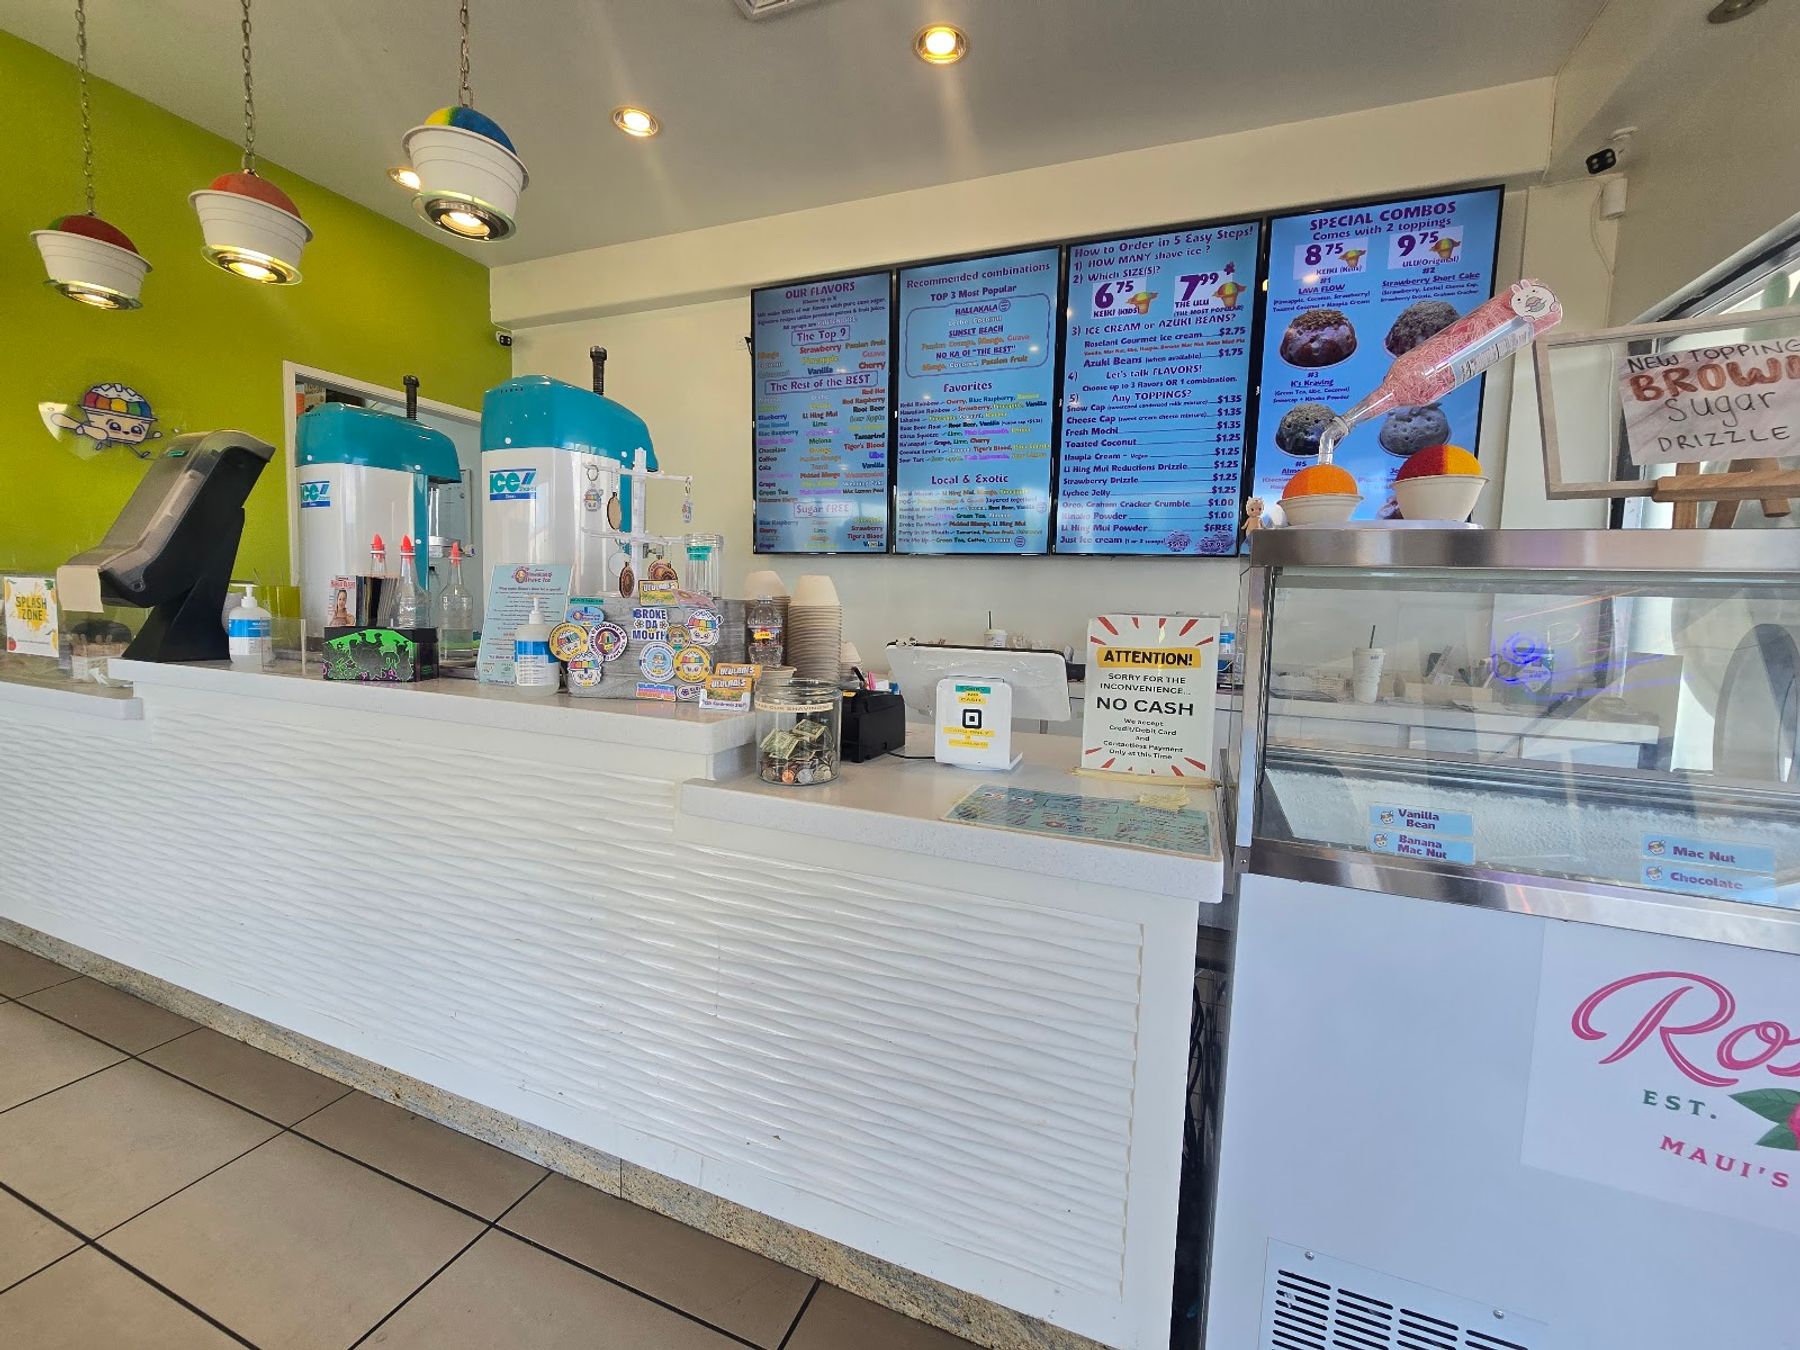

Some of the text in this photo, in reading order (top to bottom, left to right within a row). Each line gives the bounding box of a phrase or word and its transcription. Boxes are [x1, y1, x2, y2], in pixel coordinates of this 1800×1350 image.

[1310, 201, 1456, 231] SPECIAL COMBOS
[1313, 218, 1451, 241] Comes with 2 toppings
[1074, 248, 1100, 257] How
[1104, 245, 1114, 253] to
[1120, 241, 1154, 252] Order
[1158, 238, 1170, 246] in
[1185, 232, 1212, 244] Easy
[1217, 226, 1253, 240] Steps!
[1074, 261, 1082, 271] 1)
[1088, 257, 1114, 268] HOW
[1118, 253, 1150, 264] MANY
[1155, 251, 1183, 260] shave
[1187, 247, 1201, 255] ice
[907, 263, 1050, 288] Recommended combinations
[1073, 266, 1160, 284] 2) Which SIZE(S)?
[1382, 277, 1430, 287] Strawberry
[785, 282, 855, 299] OUR FLAVORS
[931, 285, 1017, 301] TOP 3 Most Popular
[1321, 284, 1345, 293] FLOW
[1193, 299, 1209, 307] ULU
[949, 325, 1003, 337] SUNSET BEACH
[1072, 326, 1081, 336] 3)
[1086, 326, 1100, 335] ICE
[1104, 323, 1140, 333] CREAM
[1158, 317, 1192, 327] AZUKI
[1195, 313, 1236, 324] BEANS?
[797, 328, 846, 341] The Top 9
[1084, 340, 1118, 348] Roselani
[1121, 336, 1157, 345] Gourmet
[1219, 327, 1246, 336] $2.75
[1084, 358, 1110, 368] Azuki
[1113, 357, 1142, 365] Beans
[1218, 348, 1243, 357] $1.75
[1627, 354, 1679, 373] NEW
[1068, 365, 1202, 380] 4) Let's talk FLAVORS!
[770, 375, 870, 391] The Rest of the BEST
[943, 382, 992, 392] Favorites
[1066, 421, 1241, 436] Fresh Mochi $1.35
[1066, 440, 1098, 448] Toasted
[1216, 434, 1241, 442] $1.25
[1658, 426, 1791, 452] DRIZZLE
[1064, 453, 1092, 461] Haupia
[1215, 447, 1239, 456] $1.25
[932, 474, 1008, 485] Local & Exotic
[1063, 477, 1107, 485] Strawberry
[1063, 489, 1089, 497] Lychee
[1091, 489, 1111, 497] Jelly
[797, 506, 823, 516] Sugar
[16, 596, 47, 608] SPLASH
[22, 610, 43, 621] ZONE
[633, 609, 666, 618] BROKE
[646, 620, 657, 628] DA
[633, 631, 667, 640] MOUTH
[1104, 650, 1192, 666] ATTENTION!
[1109, 673, 1141, 681] SORRY
[1143, 675, 1163, 683] FOR
[1096, 696, 1194, 716] NO CASH
[1109, 725, 1156, 734] Credit/Debit
[1138, 719, 1164, 727] accept
[1103, 741, 1183, 752] Contactless Payment
[1398, 808, 1440, 821] Vanilla
[1406, 820, 1435, 830] Bean
[1399, 835, 1442, 849] Banana
[1397, 844, 1447, 860] Mac Nut
[1673, 846, 1736, 863] Mac Nut
[1670, 871, 1743, 891] Chocolate
[1643, 1089, 1717, 1119] EST.
[1660, 1135, 1789, 1188] MAUI'S
